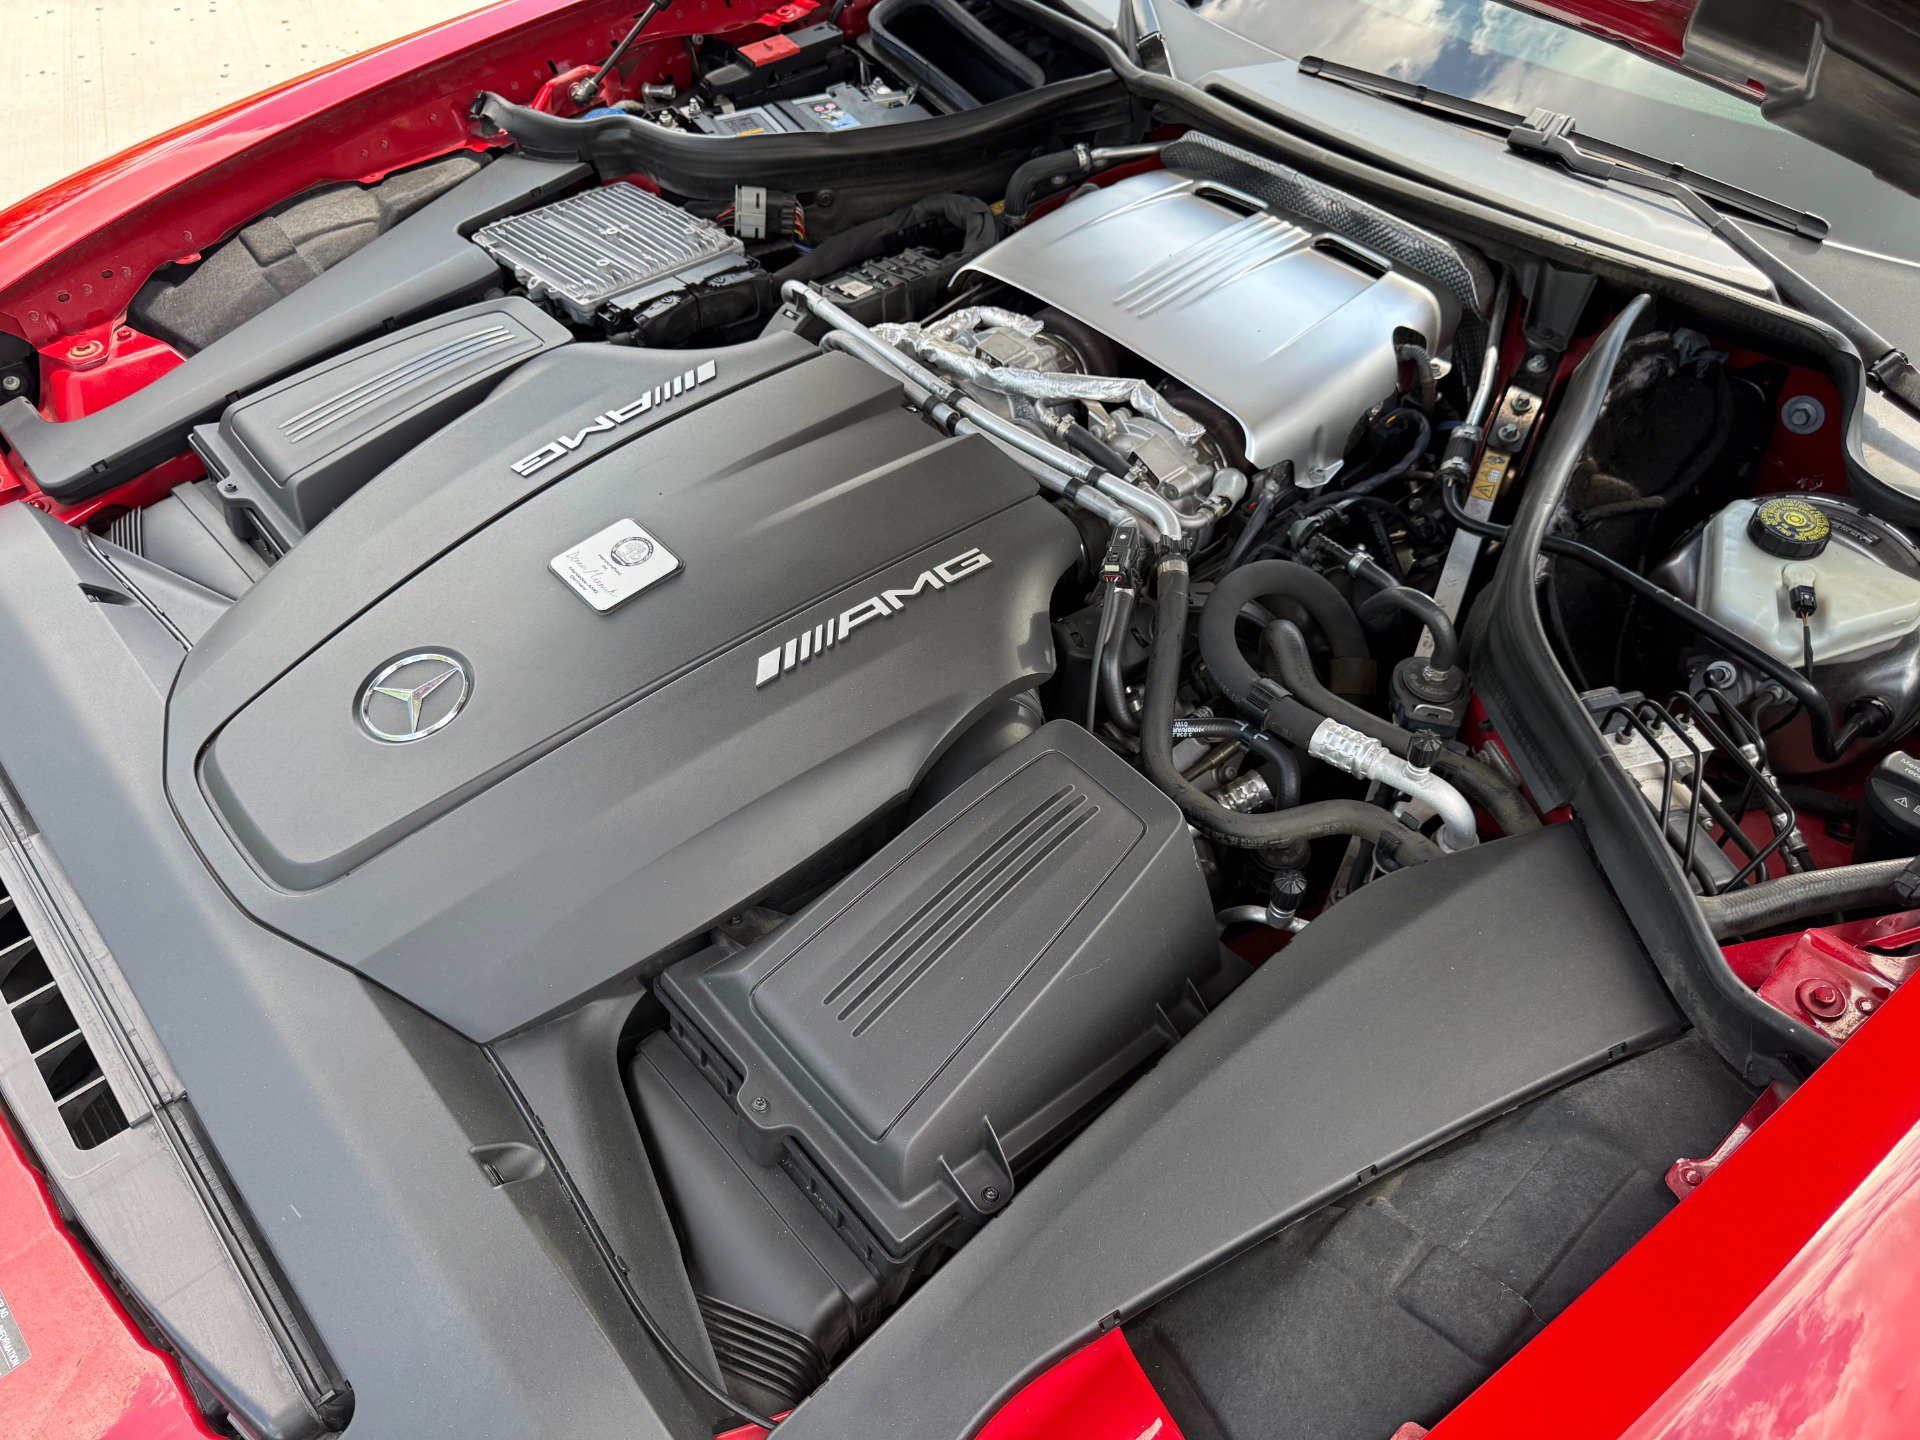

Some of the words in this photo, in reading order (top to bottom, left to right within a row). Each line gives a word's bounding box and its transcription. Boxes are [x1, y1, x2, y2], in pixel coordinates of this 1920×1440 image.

[511, 390, 652, 477] AMG
[568, 566, 599, 594] Mercedes-AMG
[838, 548, 993, 641] AMG
